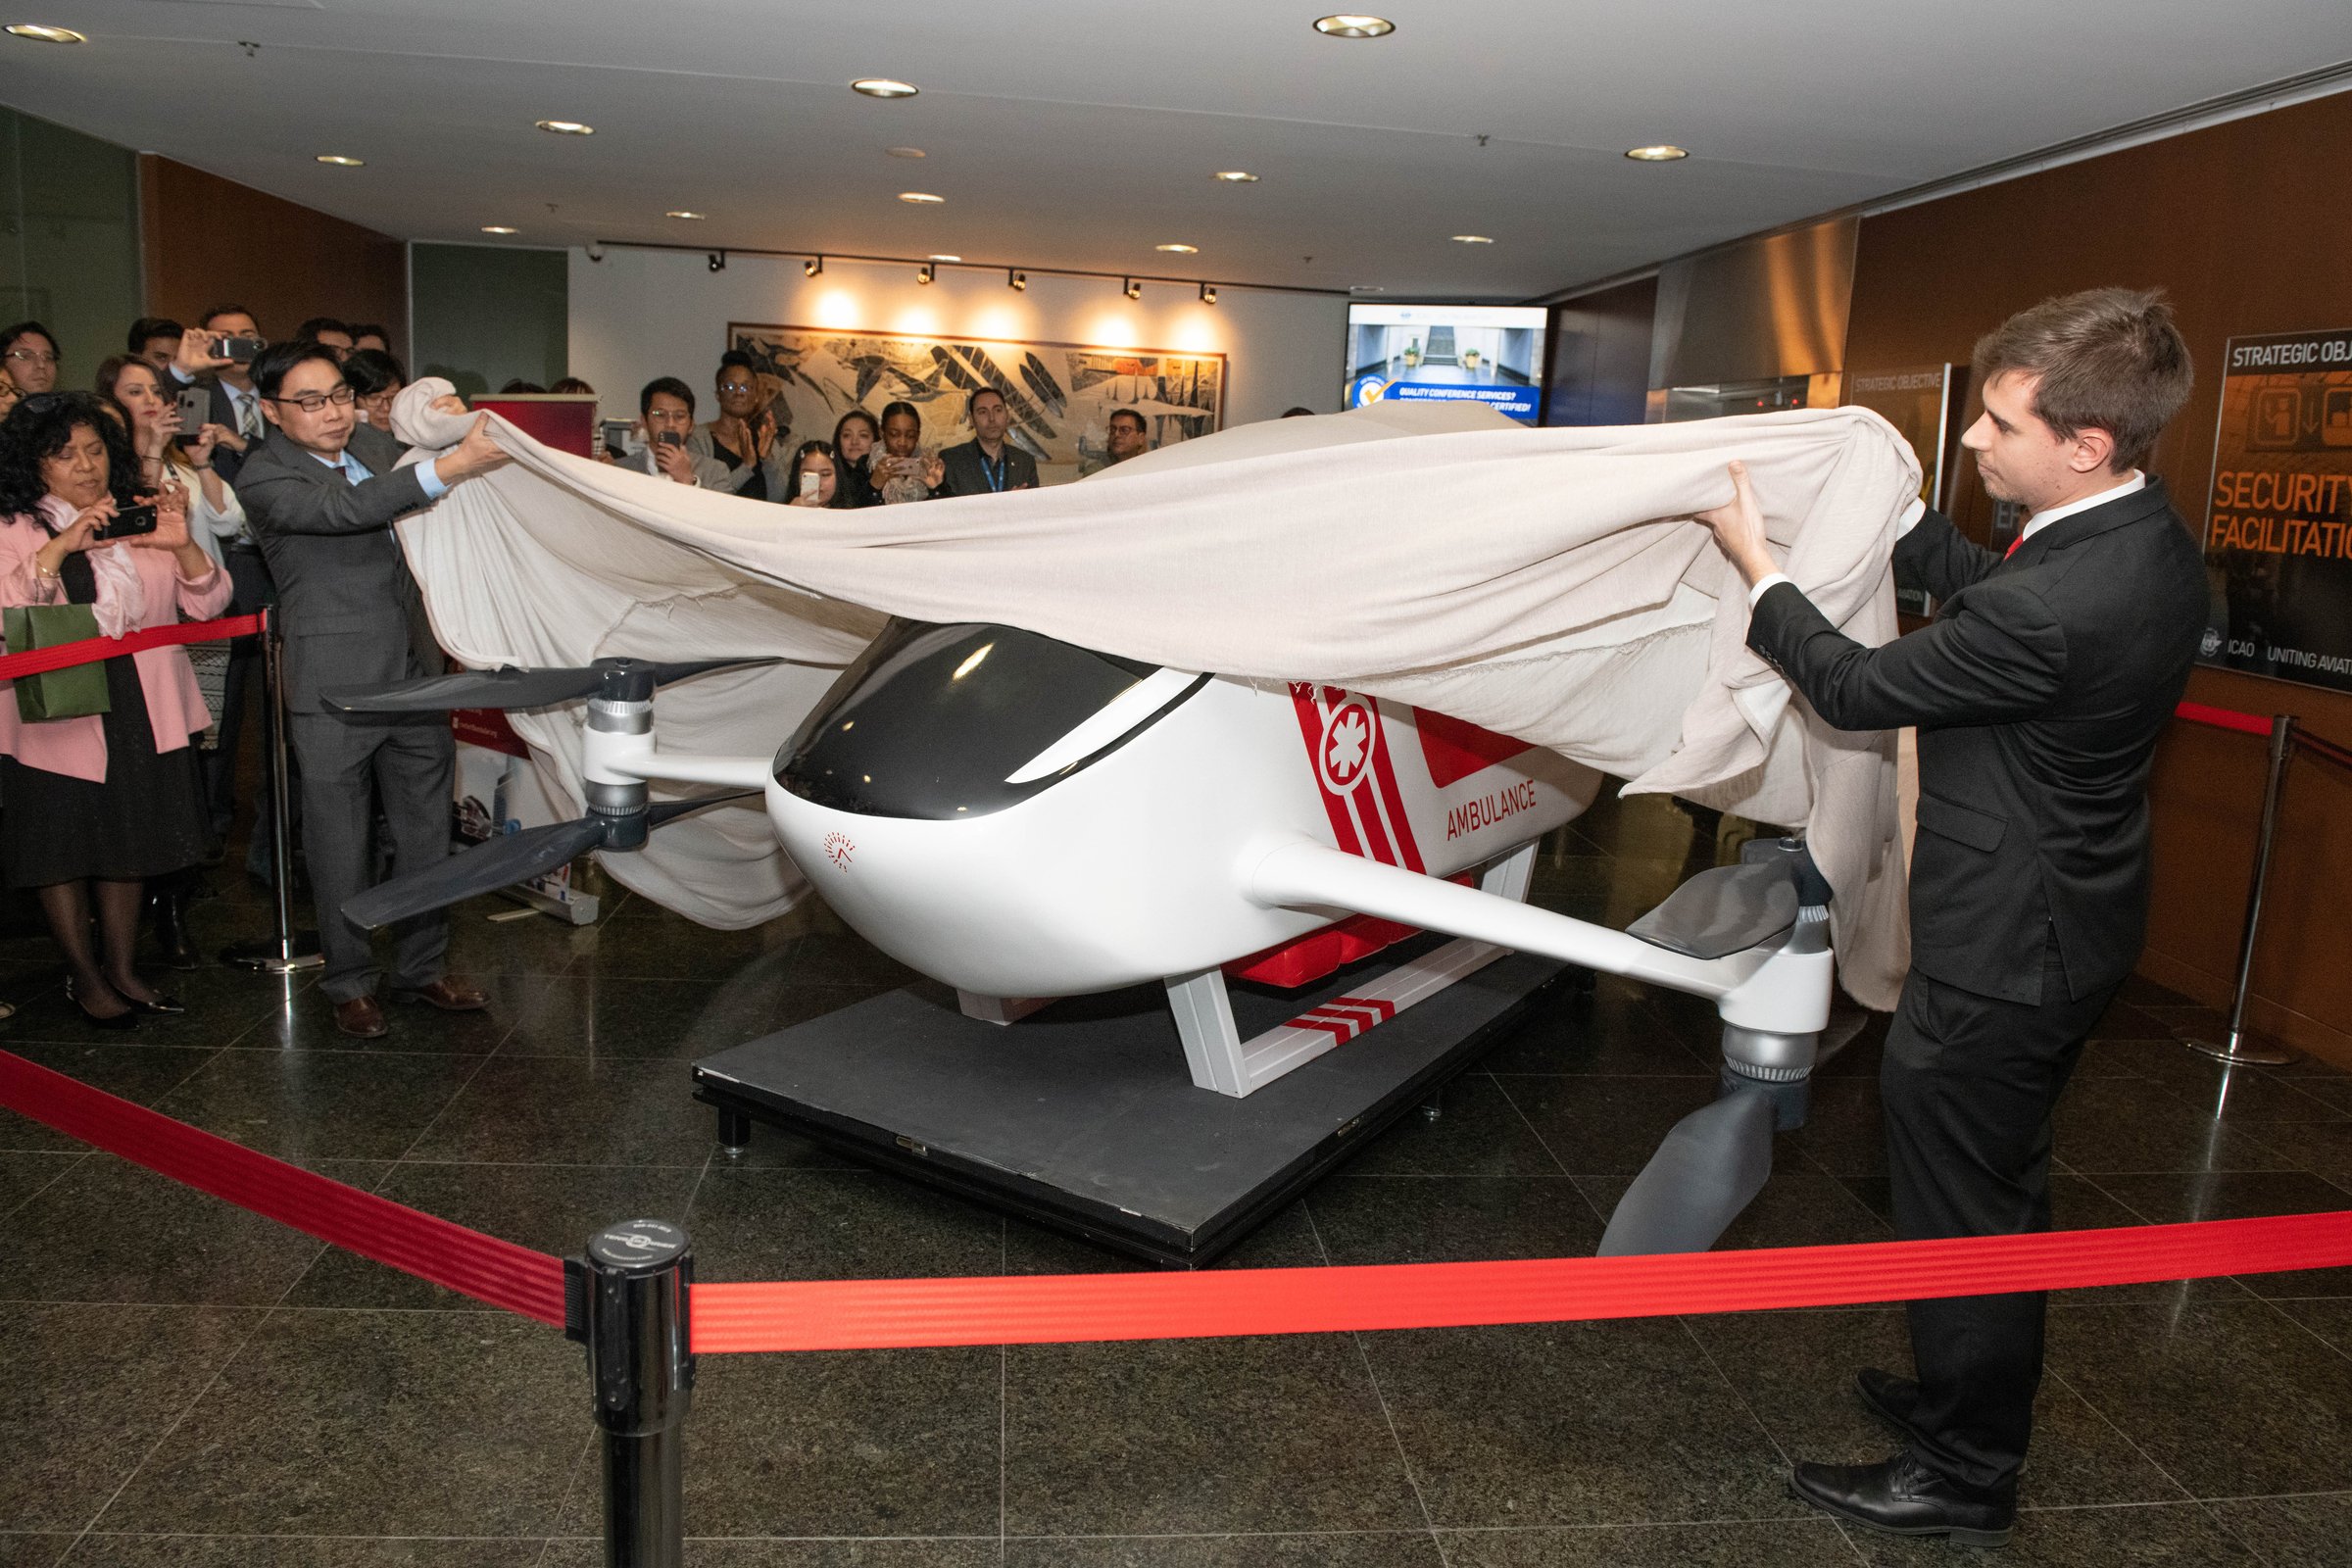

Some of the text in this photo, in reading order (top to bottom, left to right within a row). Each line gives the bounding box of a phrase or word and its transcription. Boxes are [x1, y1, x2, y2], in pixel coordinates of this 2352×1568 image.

[2232, 342, 2319, 367] STRATEGIC
[1399, 387, 1429, 397] QUALITY
[1429, 388, 1477, 400] CONFERENCE
[2214, 470, 2352, 514] SECURIT
[2228, 639, 2255, 658] ICAO
[2267, 646, 2317, 668] UNITING
[1446, 780, 1537, 842] AMBULANCE
